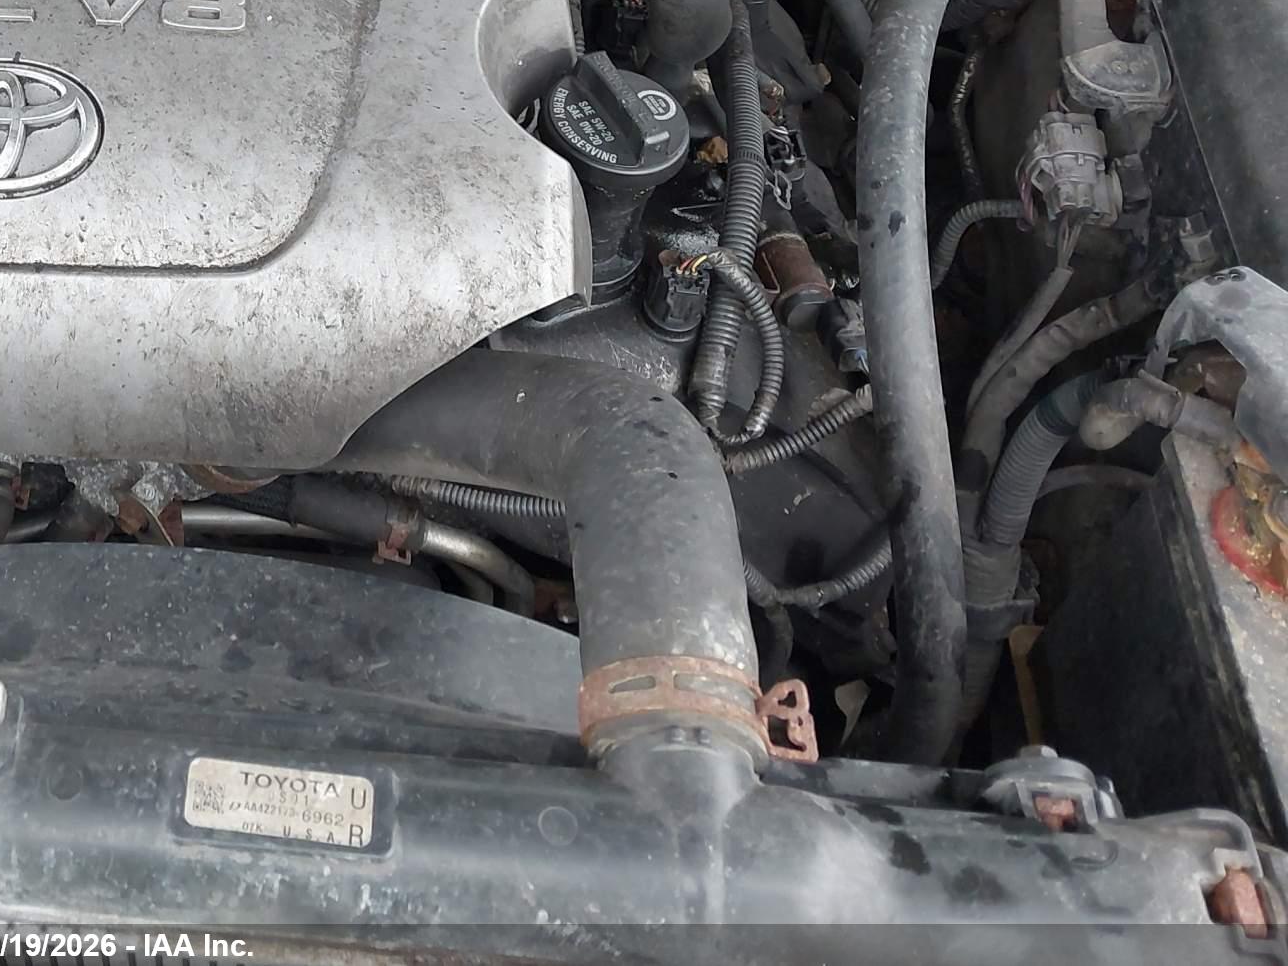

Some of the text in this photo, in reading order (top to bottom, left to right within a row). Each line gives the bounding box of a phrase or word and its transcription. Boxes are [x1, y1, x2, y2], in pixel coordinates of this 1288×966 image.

[551, 87, 569, 121] ENERGY
[566, 103, 604, 147] SAE 0W-20
[578, 99, 616, 143] SAE 5W-20
[558, 120, 618, 165] CONSERVING
[239, 771, 367, 811] TOYOTA U
